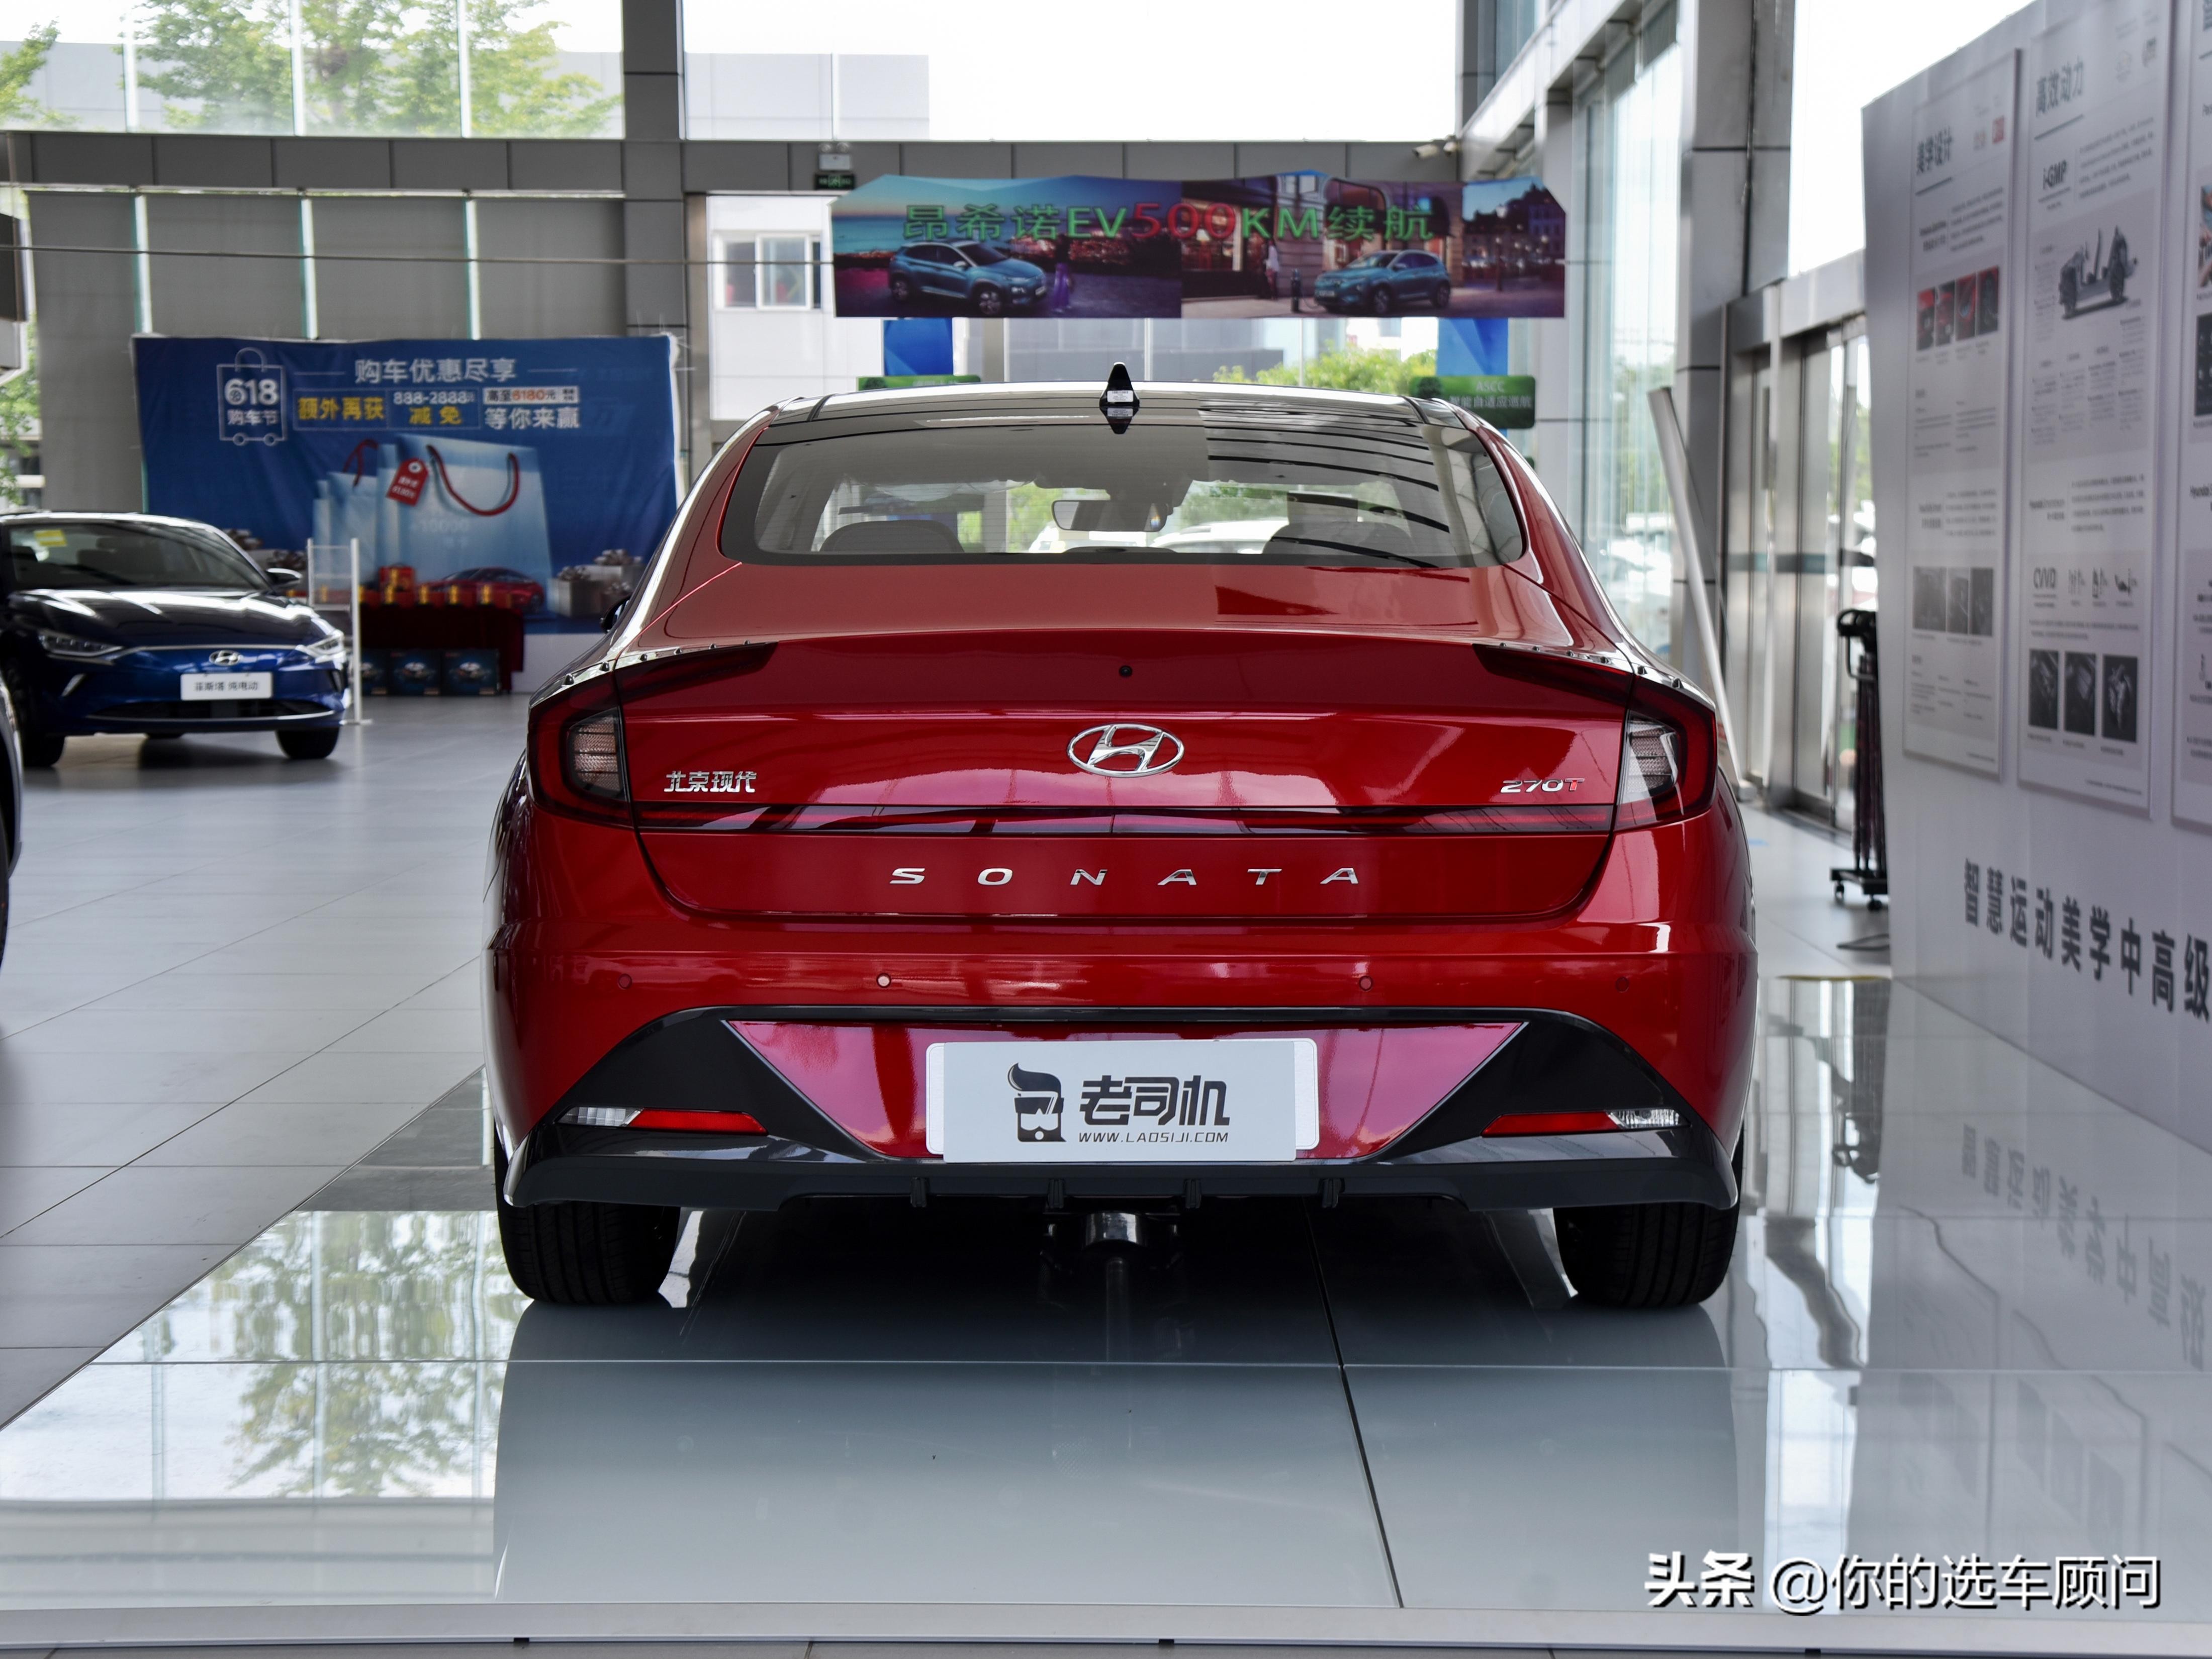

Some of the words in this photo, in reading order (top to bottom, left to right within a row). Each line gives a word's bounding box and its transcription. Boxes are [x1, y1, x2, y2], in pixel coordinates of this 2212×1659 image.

[903, 202, 1434, 242] 昂希诺EV500KM续航
[354, 357, 516, 384] 购车优惠尽享
[224, 378, 280, 405] 618
[1476, 380, 1505, 392] ASCC
[227, 409, 278, 426] 购车节
[298, 397, 385, 420] 额外再获
[485, 407, 580, 429] 等你来赢
[664, 770, 757, 793] 北京现代
[1500, 778, 1585, 793] 270T
[889, 867, 1358, 885] SONATA
[1963, 858, 2210, 1023] 智慧运动美学中高级
[1079, 1075, 1230, 1126] 老司机
[1079, 1132, 1228, 1143] WWW.LAOSIJI.COM
